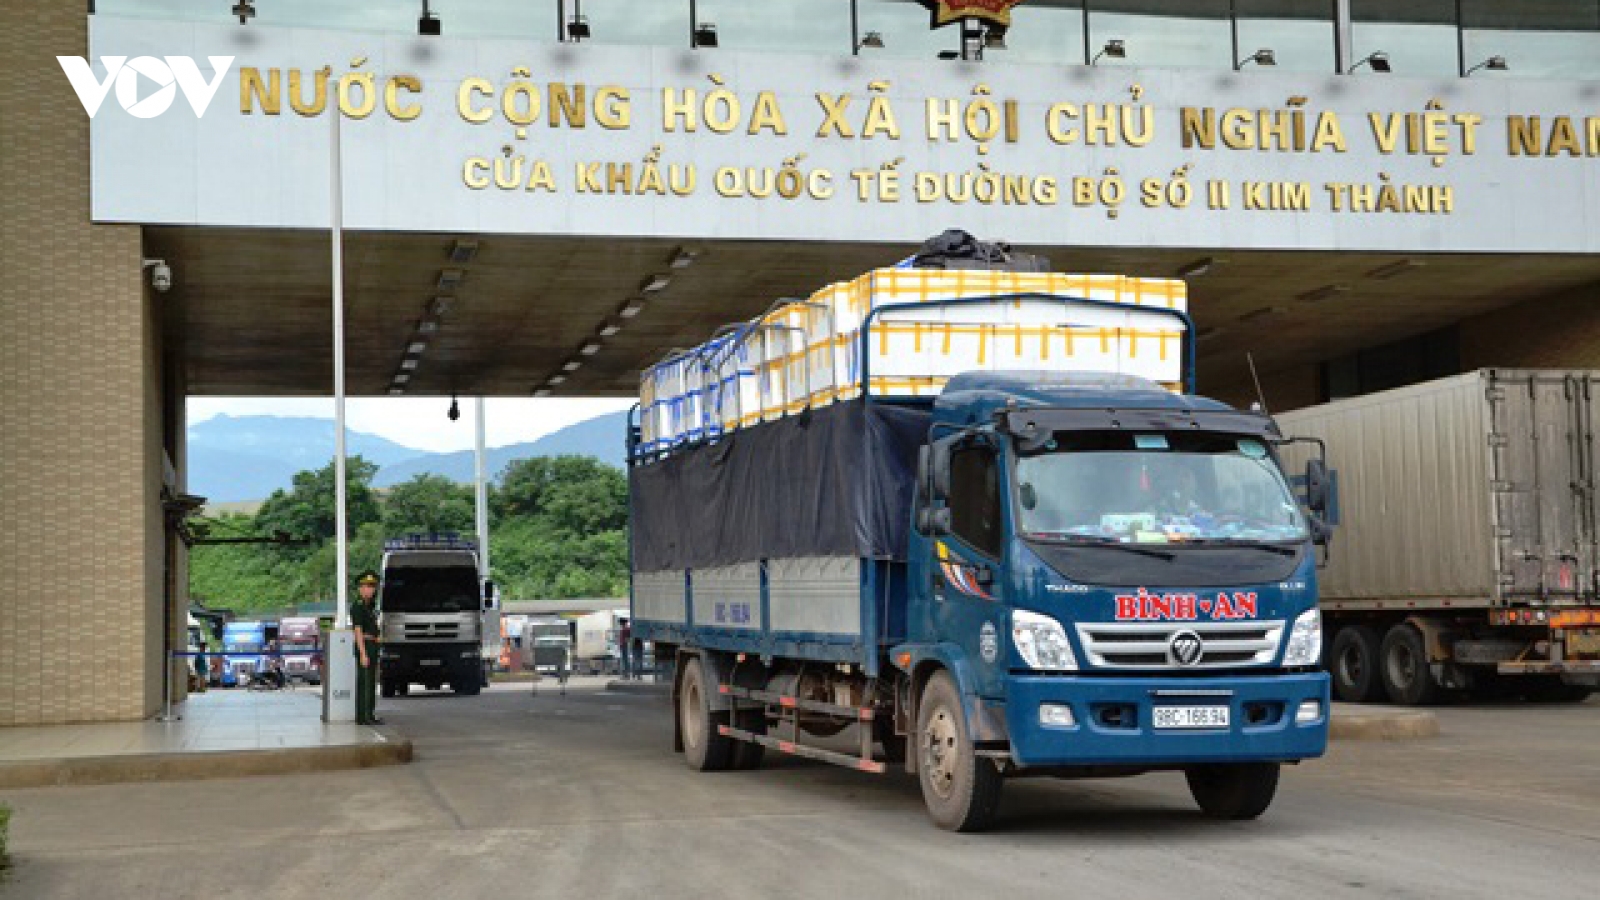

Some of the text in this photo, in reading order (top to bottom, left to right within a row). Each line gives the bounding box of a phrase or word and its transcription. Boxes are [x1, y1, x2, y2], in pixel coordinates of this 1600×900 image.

[239, 57, 422, 121] NƯỚC
[457, 66, 632, 140] CỘNG
[662, 75, 787, 136] HÒA
[815, 81, 900, 139] XÃ
[925, 84, 1020, 156] HỘI
[1047, 84, 1155, 148] CHỦ
[1180, 96, 1347, 153] NGHĨA
[1368, 100, 1482, 167] VIỆT
[463, 143, 1454, 219] CỬA KHẨU QUỐC TẾ ĐƯỜNG BỘ SỐ II KIM THÀNH
[1211, 592, 1258, 619] AN
